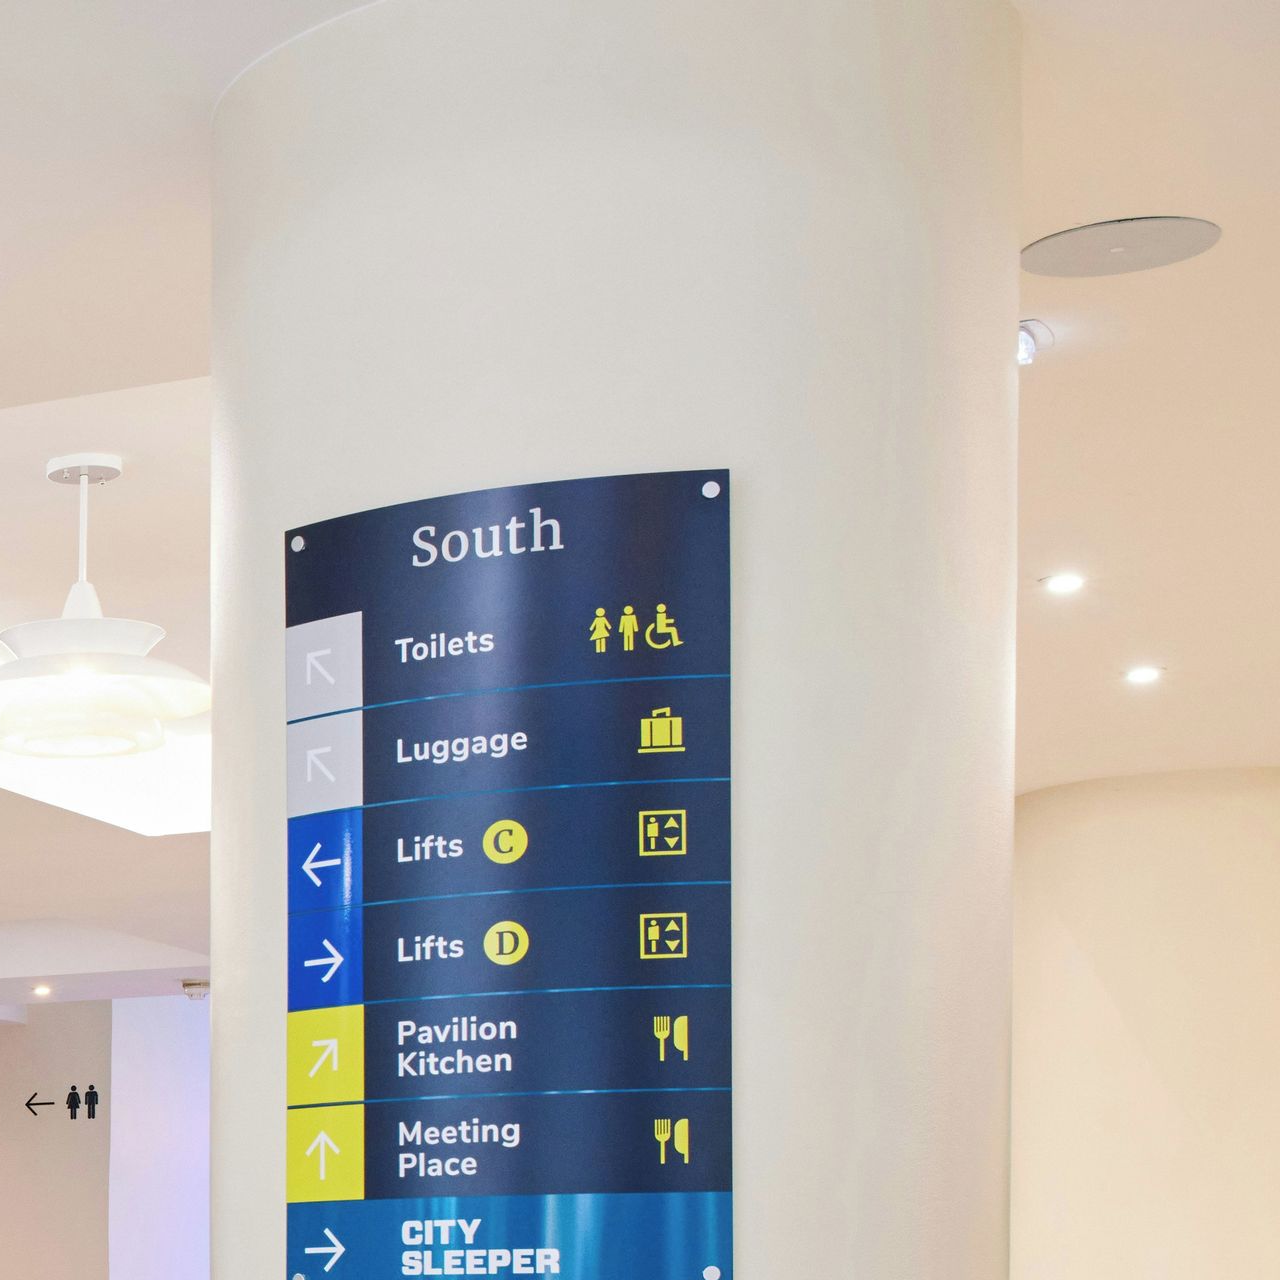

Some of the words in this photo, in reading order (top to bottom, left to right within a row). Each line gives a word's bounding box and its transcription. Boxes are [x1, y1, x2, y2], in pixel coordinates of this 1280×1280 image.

[411, 507, 564, 567] South
[394, 630, 495, 663] Toilets
[396, 729, 528, 764] Luggage
[396, 833, 464, 863] Lifts
[492, 828, 514, 855] C
[397, 935, 464, 962] Lifts
[496, 930, 520, 957] D
[397, 1017, 518, 1045] Pavilion
[397, 1048, 513, 1077] Kitchen
[398, 1118, 521, 1148] Meeting
[398, 1152, 478, 1178] Place
[401, 1218, 482, 1245] CITY
[401, 1247, 560, 1276] SLEEPER
